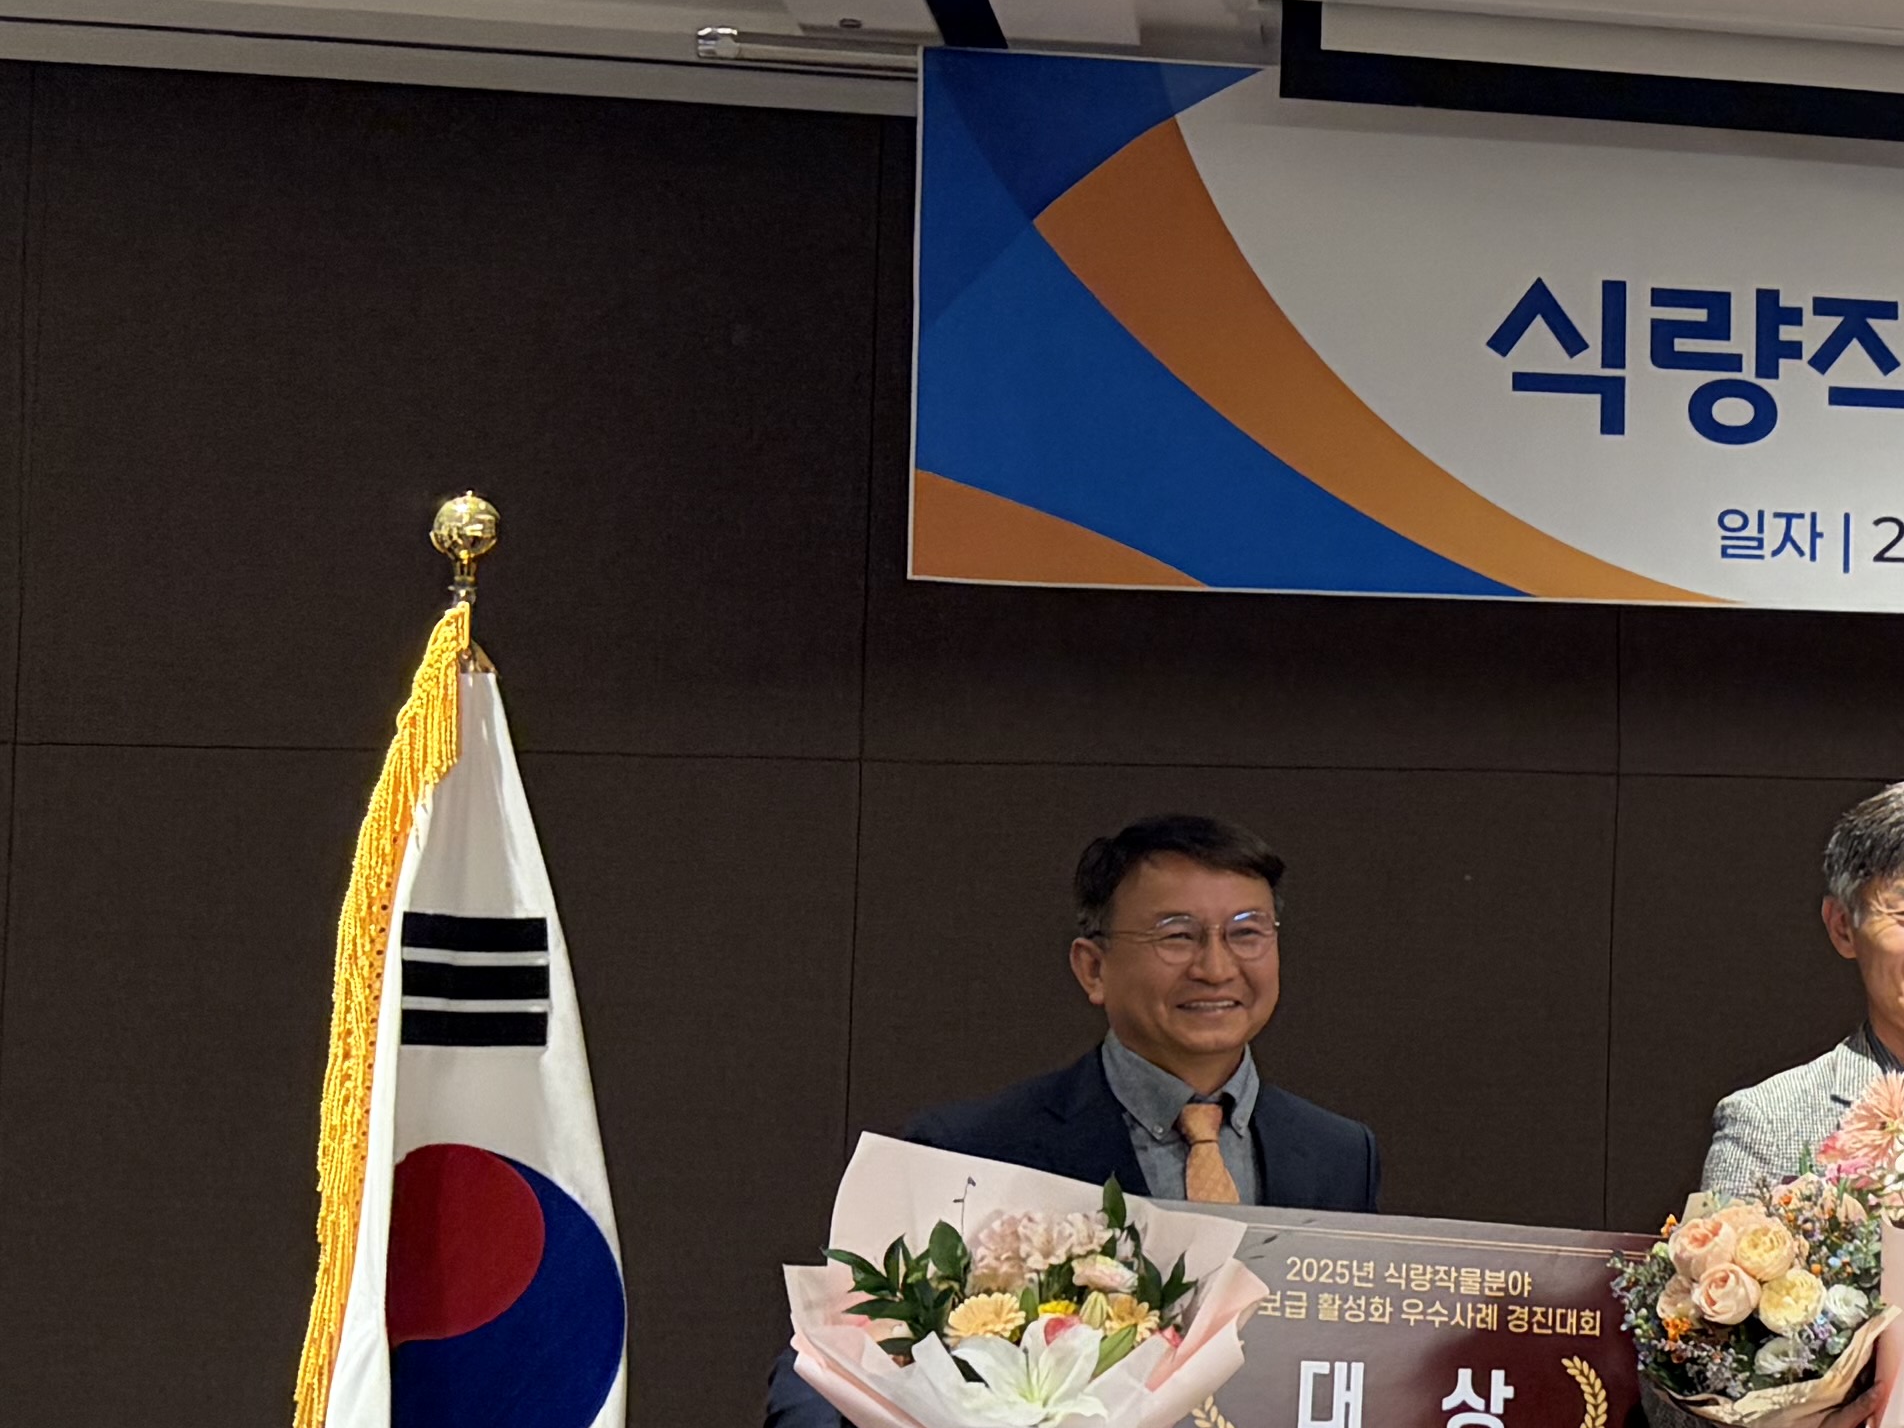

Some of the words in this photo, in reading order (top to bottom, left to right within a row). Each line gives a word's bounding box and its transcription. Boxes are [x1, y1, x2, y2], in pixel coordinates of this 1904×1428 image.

[1716, 507, 1824, 563] 일자
[1286, 1256, 1376, 1289] 2025년
[1384, 1262, 1533, 1298] 식량작물분야
[1317, 1292, 1394, 1324] 활성화
[1401, 1298, 1499, 1332] 우수사례
[1506, 1304, 1602, 1338] 경진대회
